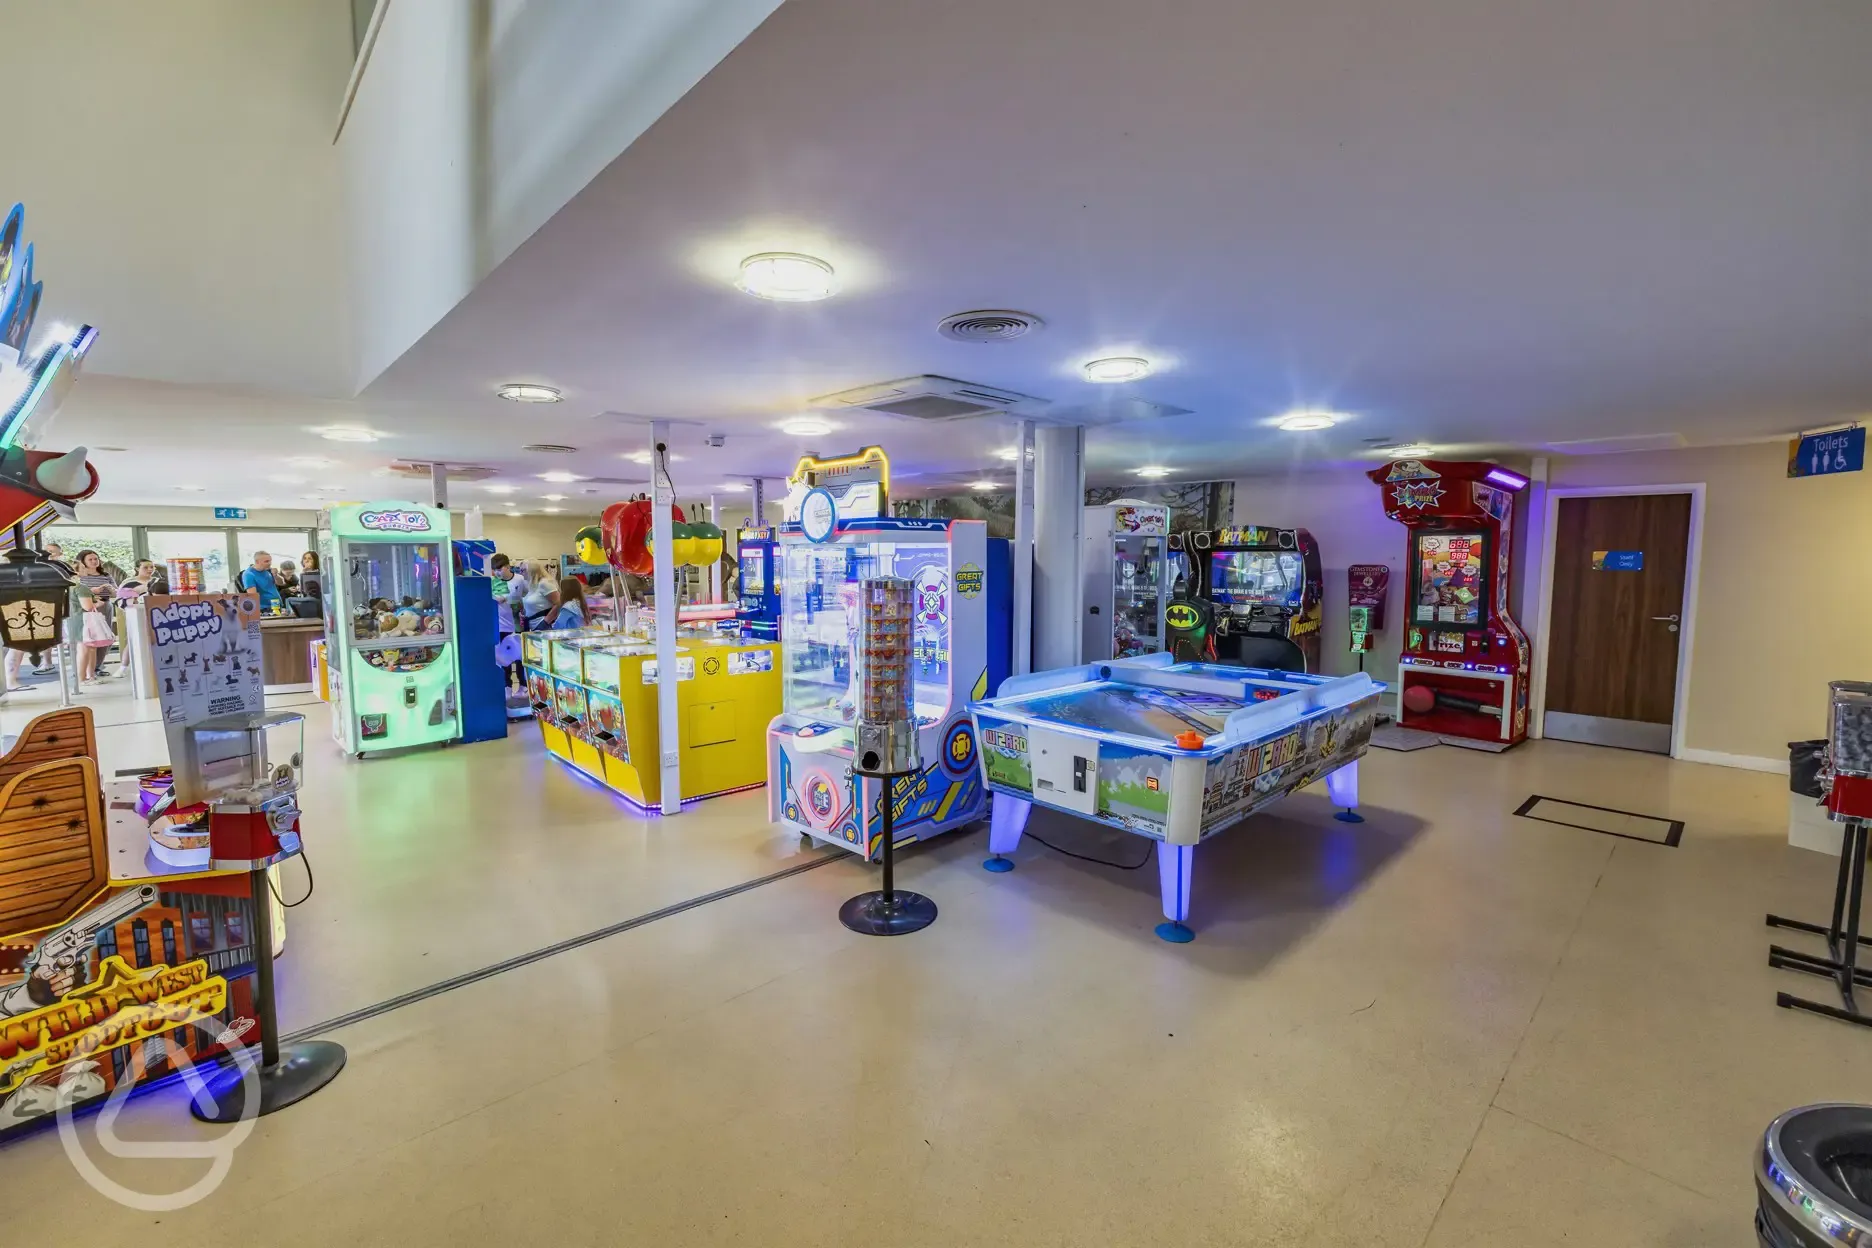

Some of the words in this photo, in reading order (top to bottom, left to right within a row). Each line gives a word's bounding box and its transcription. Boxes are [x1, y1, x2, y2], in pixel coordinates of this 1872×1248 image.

[1813, 435, 1849, 452] Toilets
[1219, 528, 1269, 544] BATMAN
[956, 572, 983, 581] GREAT
[958, 583, 982, 592] GIFTS
[152, 601, 213, 628] Adopt
[156, 616, 220, 645] Puppy
[210, 695, 241, 705] WARNING
[985, 729, 1028, 754] WIZARD
[1246, 731, 1299, 780] WIZARD
[0, 994, 119, 1060] WILD
[127, 964, 205, 1004] WEST
[46, 984, 223, 1066] SHOOTOUT
